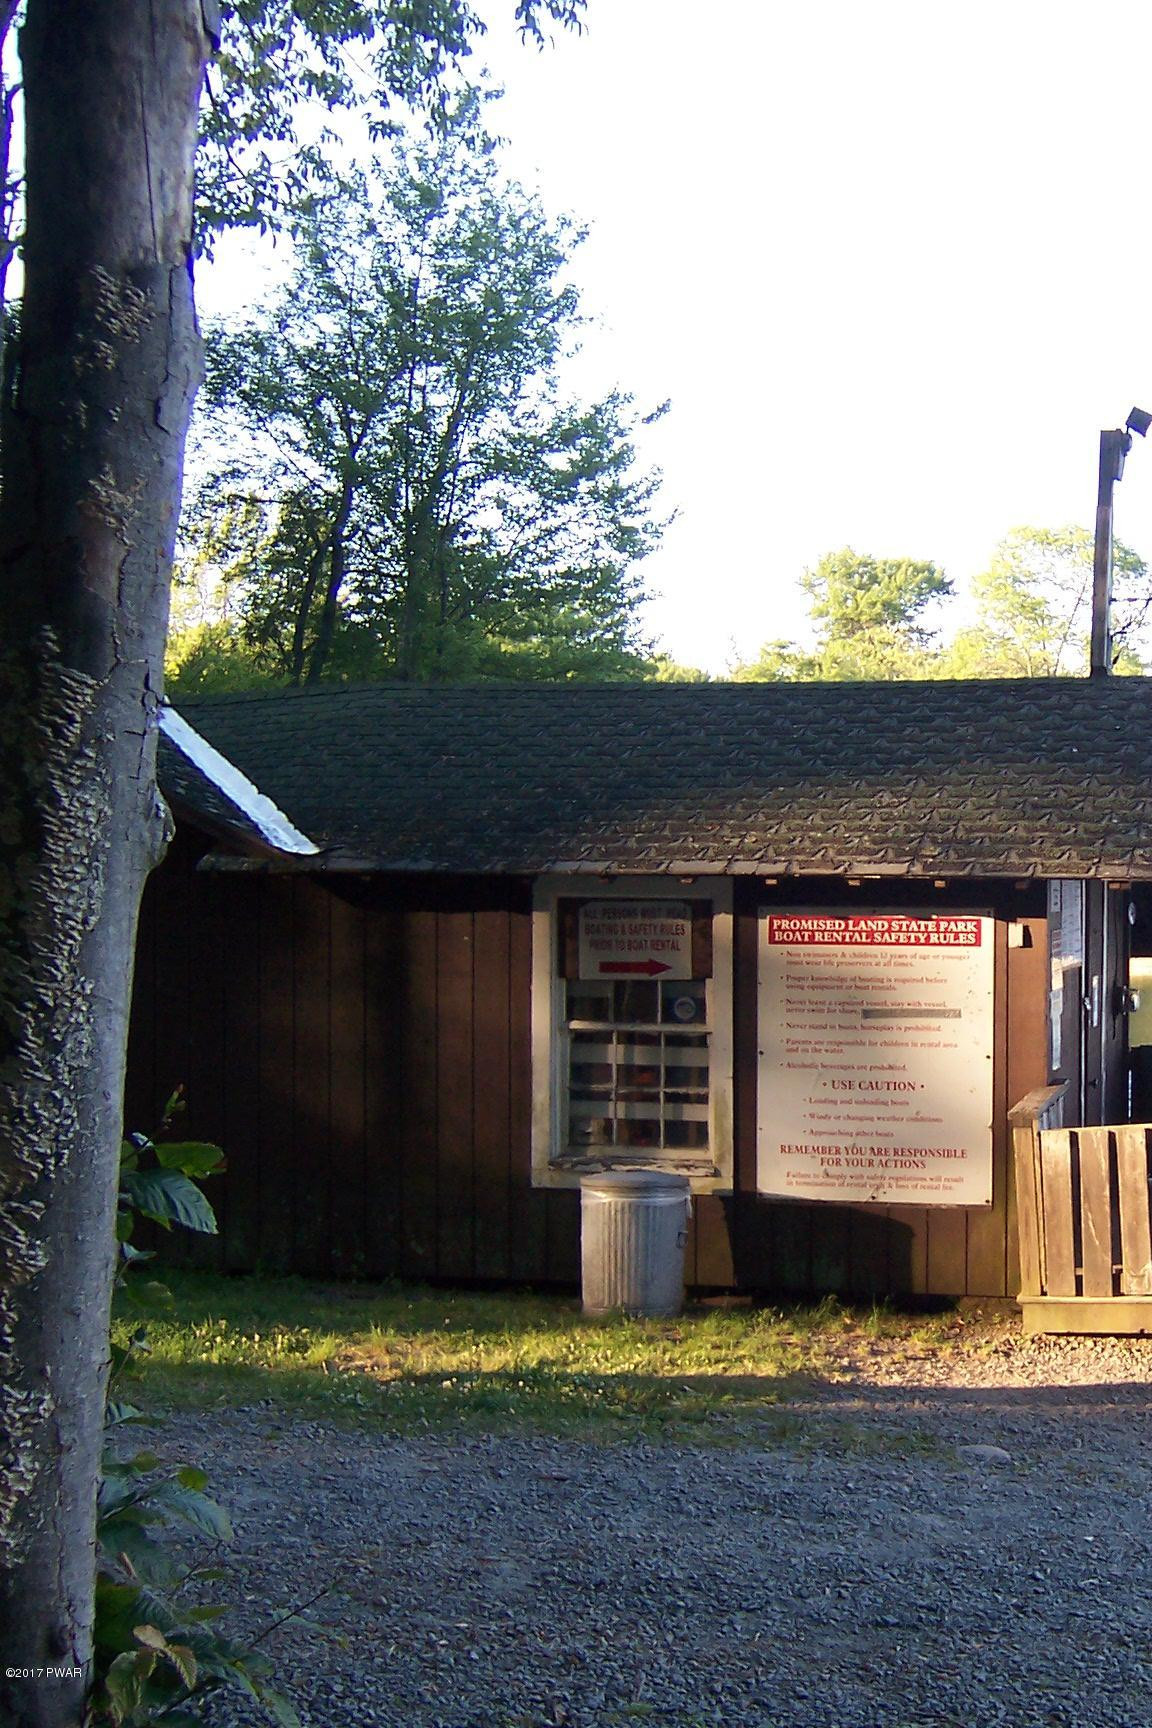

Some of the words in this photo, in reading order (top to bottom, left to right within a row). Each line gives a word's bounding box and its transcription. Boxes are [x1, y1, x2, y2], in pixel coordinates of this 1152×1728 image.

[585, 923, 618, 936] BOATING
[628, 923, 658, 936] SAFETY
[660, 923, 686, 936] RULES
[773, 919, 845, 931] PROMISED
[848, 919, 889, 931] LAND
[891, 920, 937, 932] STATE
[939, 921, 978, 933] PARK
[774, 931, 812, 943] BOAT
[814, 931, 871, 943] RENTAL
[873, 932, 928, 944] SAFETY
[929, 933, 976, 945] RULES
[627, 939, 649, 952] BOAT
[650, 939, 681, 952] RENTAL
[889, 953, 908, 961] years
[785, 998, 807, 1006] Never
[785, 1022, 807, 1030] Never
[832, 1079, 855, 1091] USE
[858, 1080, 916, 1091] CAUTION
[780, 1144, 841, 1156] REMEMBER
[844, 1145, 867, 1157] YOU
[869, 1146, 890, 1157] ARE
[893, 1147, 967, 1159] RESPONSIBLE
[820, 1156, 842, 1167] FOR
[844, 1157, 875, 1168] YOUR
[877, 1158, 927, 1169] ACTIONS
